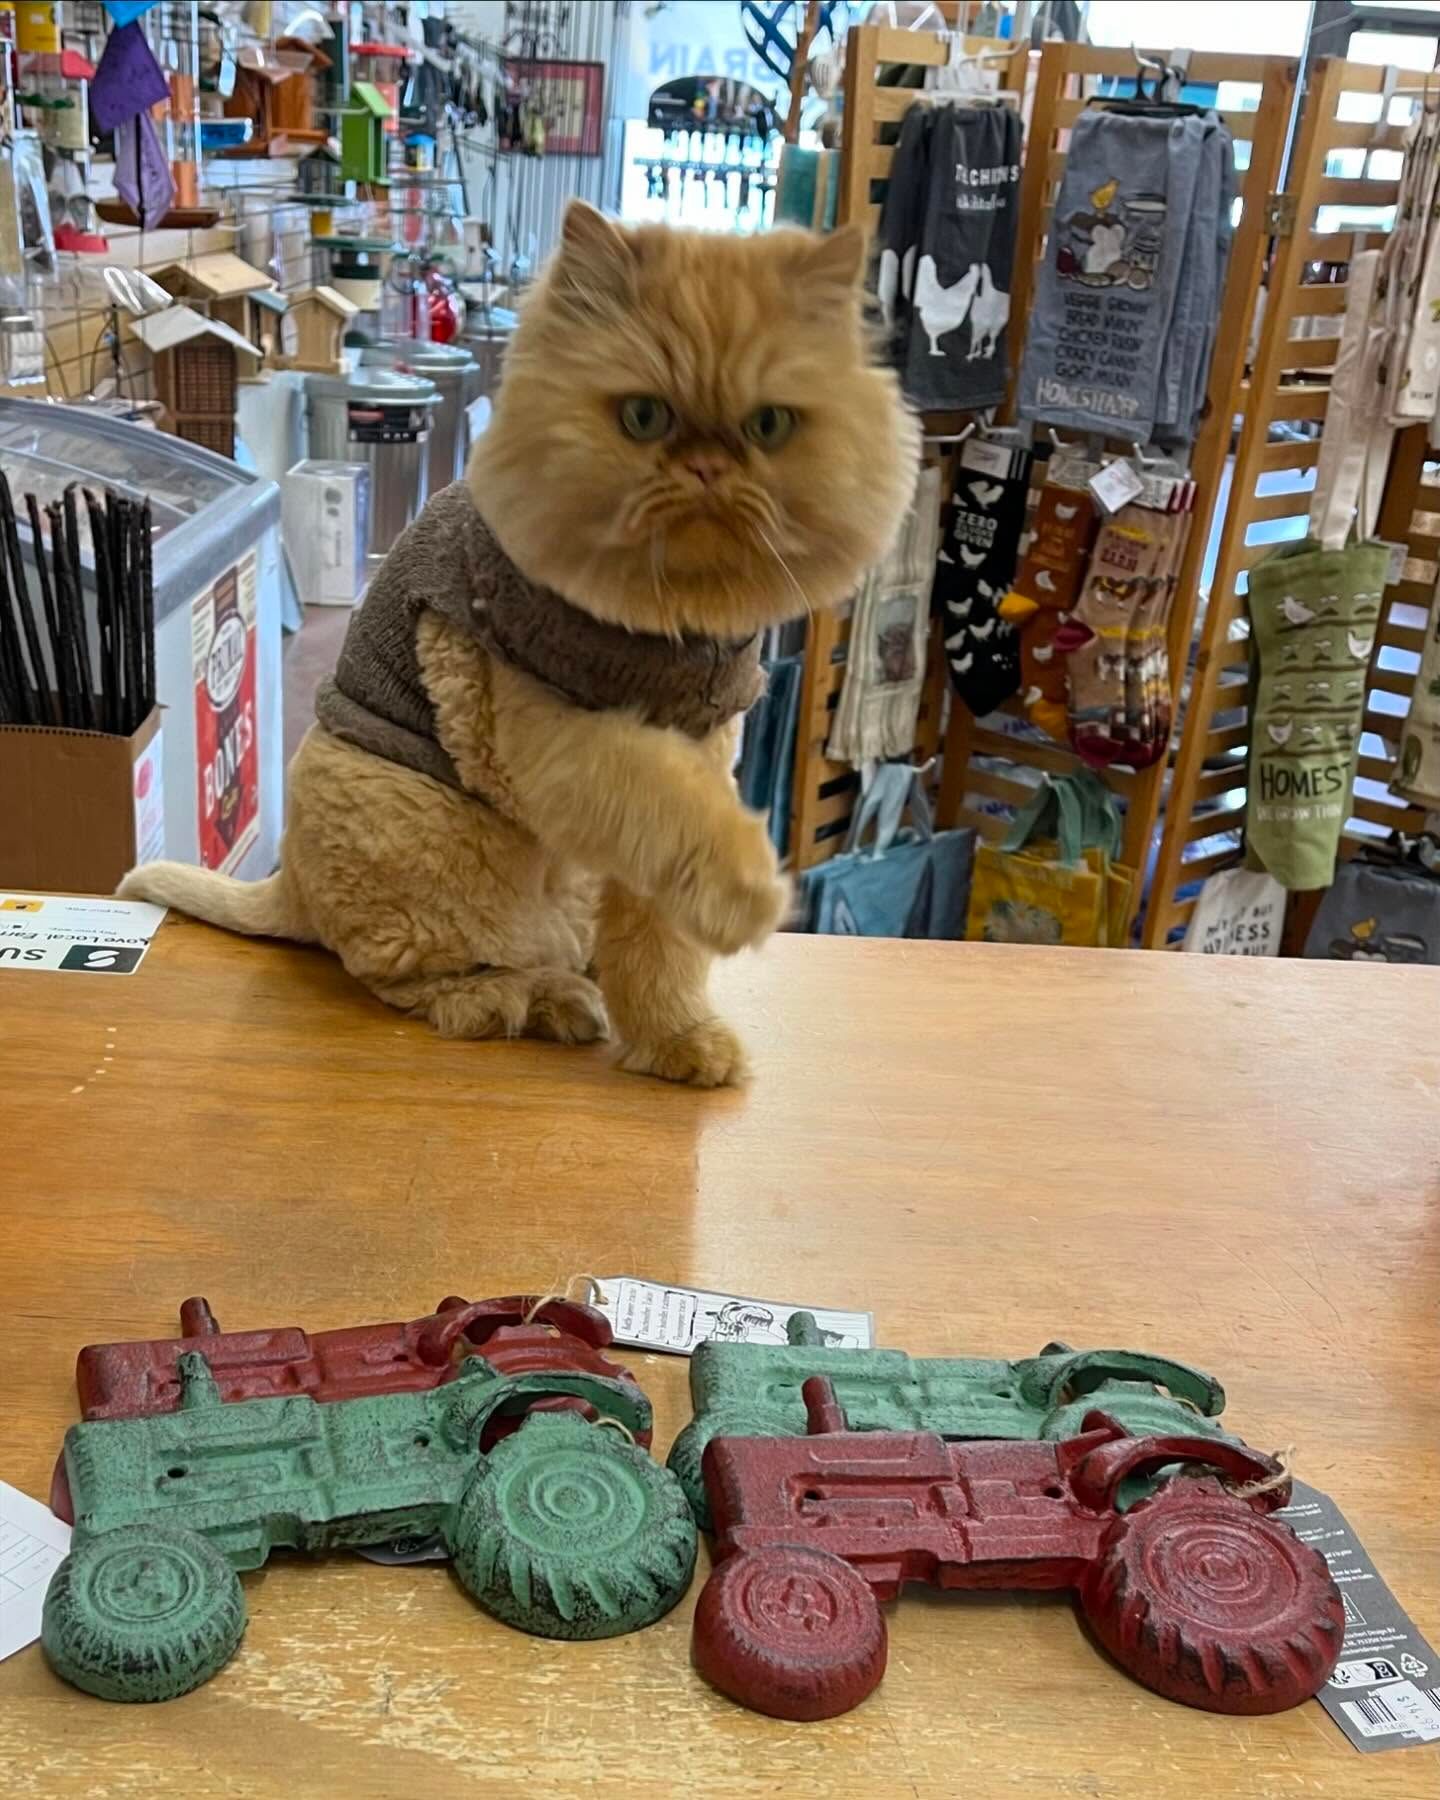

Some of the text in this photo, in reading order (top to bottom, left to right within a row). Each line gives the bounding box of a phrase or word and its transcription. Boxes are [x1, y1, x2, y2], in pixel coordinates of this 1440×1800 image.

[957, 510, 998, 530] ZERO
[204, 701, 253, 819] BONES
[104, 936, 150, 946] Love
